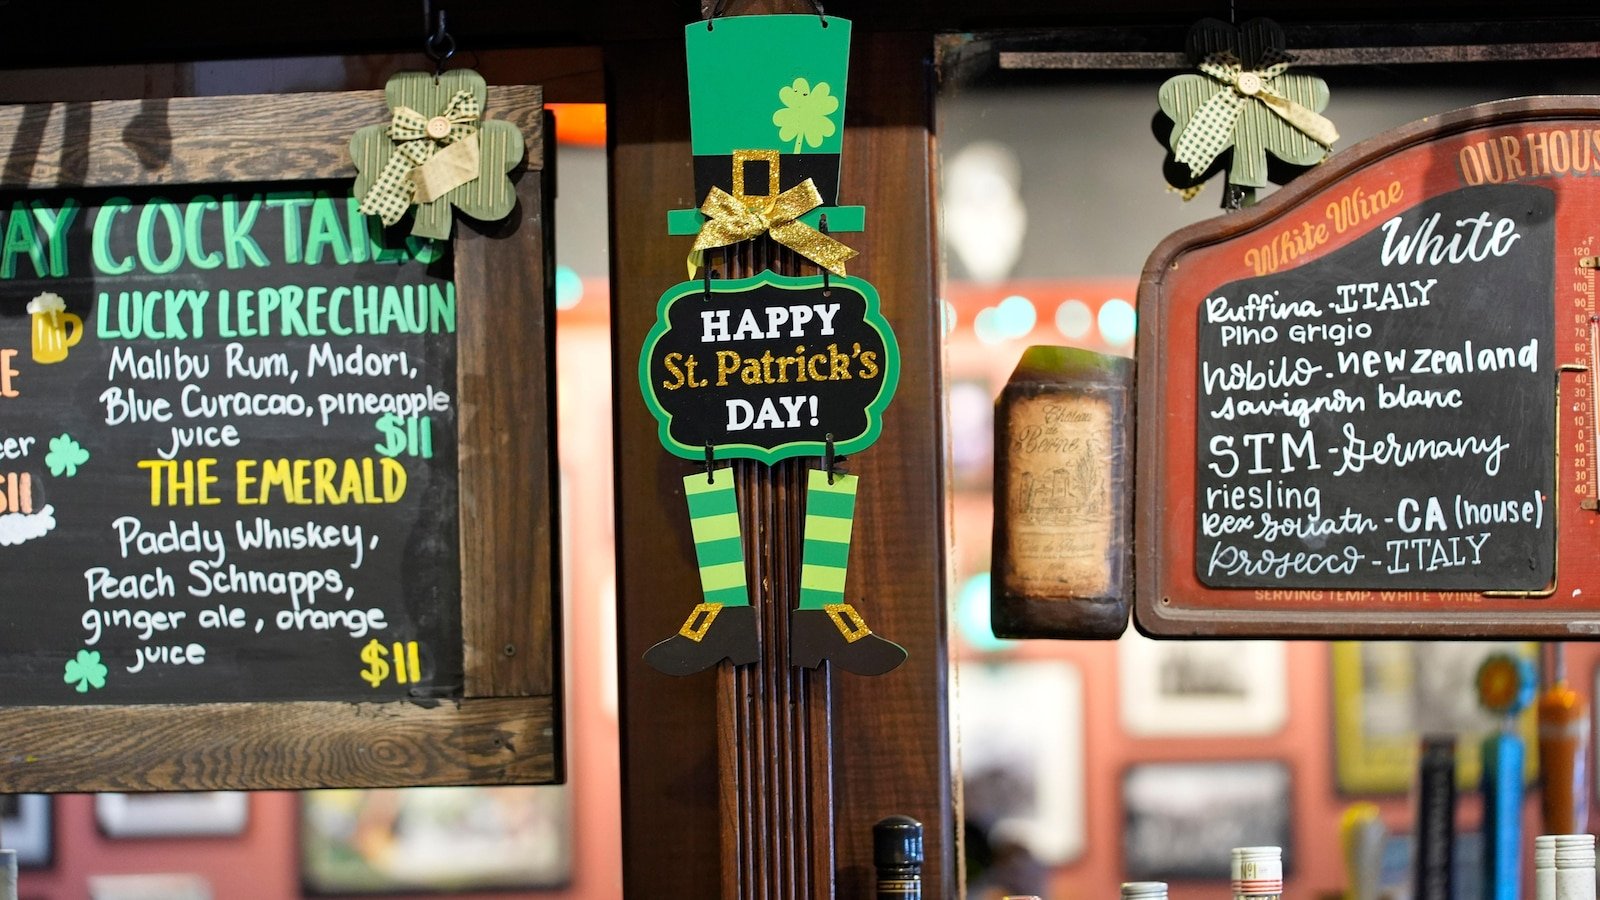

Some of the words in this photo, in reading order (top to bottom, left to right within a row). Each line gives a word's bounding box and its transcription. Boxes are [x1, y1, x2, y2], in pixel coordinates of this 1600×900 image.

[1460, 135, 1526, 186] OUR
[0, 198, 79, 279] AY
[1244, 220, 1330, 277] White
[1325, 181, 1404, 234] Wine
[1380, 210, 1522, 267] White
[1573, 247, 1590, 256] 120
[1573, 283, 1588, 292] 100
[1574, 298, 1586, 308] 90
[97, 289, 209, 339] LUCKY
[218, 282, 456, 337] LEPRECHAUN
[700, 303, 841, 343] HAPPY
[1205, 290, 1323, 324] Ruffina
[1575, 315, 1586, 324] 80
[1574, 343, 1586, 352] 60
[1575, 328, 1585, 337] 70
[108, 345, 210, 382] Malibu
[226, 342, 299, 384] Rum,
[307, 343, 418, 380] Midori,
[663, 352, 709, 391] St.
[715, 341, 879, 387] Patrick's
[1575, 374, 1587, 384] 40
[99, 388, 173, 426] Blue
[181, 384, 313, 419] Curacao,
[317, 384, 450, 425] pineapple
[1210, 388, 1366, 428] savignon
[1378, 384, 1463, 409] blanc
[1574, 388, 1586, 397] 30
[1574, 402, 1586, 411] 20
[725, 395, 819, 431] DAY!
[1574, 416, 1584, 426] 10
[0, 435, 36, 461] er
[157, 424, 240, 460] juice
[375, 412, 432, 458] $11
[1574, 443, 1585, 453] 10
[1578, 430, 1584, 439] 0
[1574, 458, 1585, 467] 20
[1575, 471, 1586, 481] 30
[137, 458, 222, 507] THE
[236, 457, 407, 505] EMERALD
[1574, 484, 1587, 494] 40
[1202, 512, 1255, 537] Rex
[1455, 490, 1544, 529] (house)
[1207, 480, 1321, 521] riesling
[112, 516, 226, 567] Paddy
[84, 566, 175, 602] Peach
[188, 560, 354, 611] Schnapps,
[1255, 590, 1323, 601] SERVING
[1329, 590, 1375, 601] TEMP.
[1380, 591, 1431, 602] WHITE
[1438, 591, 1482, 602] WINE
[81, 608, 186, 645] ginger
[276, 607, 388, 638] orange
[126, 643, 206, 673] juice
[360, 638, 421, 688] $11
